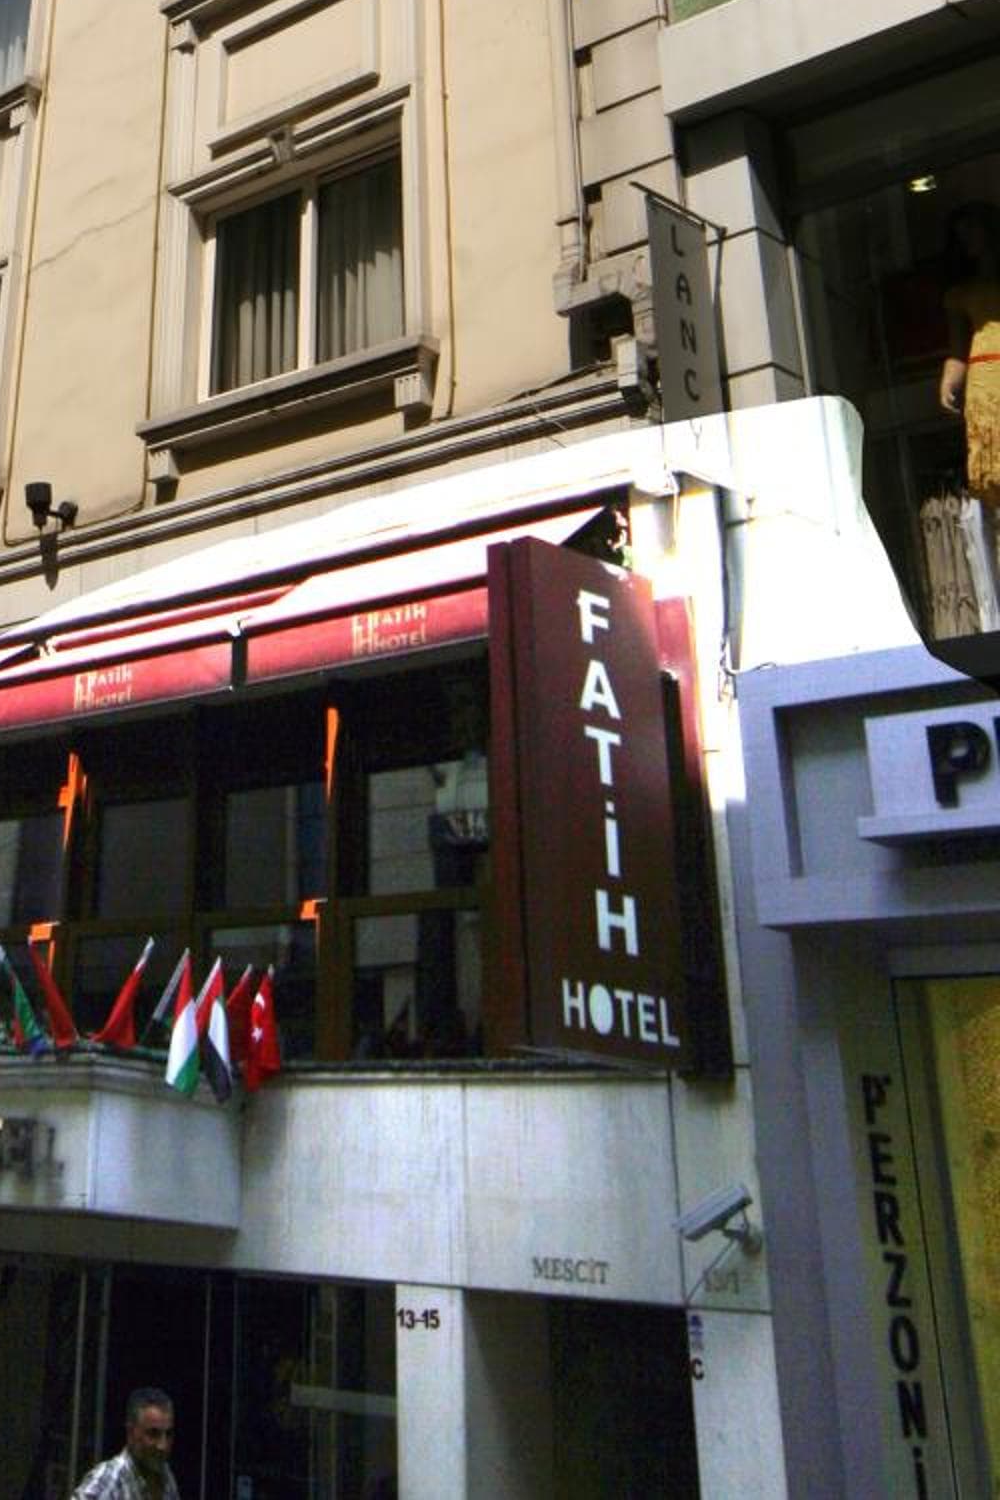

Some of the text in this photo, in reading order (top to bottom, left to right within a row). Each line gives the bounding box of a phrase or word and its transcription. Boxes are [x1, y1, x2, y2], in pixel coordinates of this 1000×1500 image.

[926, 716, 1000, 810] P
[562, 979, 680, 1047] HOTEL
[532, 1256, 610, 1286] MESCİT
[397, 1307, 440, 1330] 13-15
